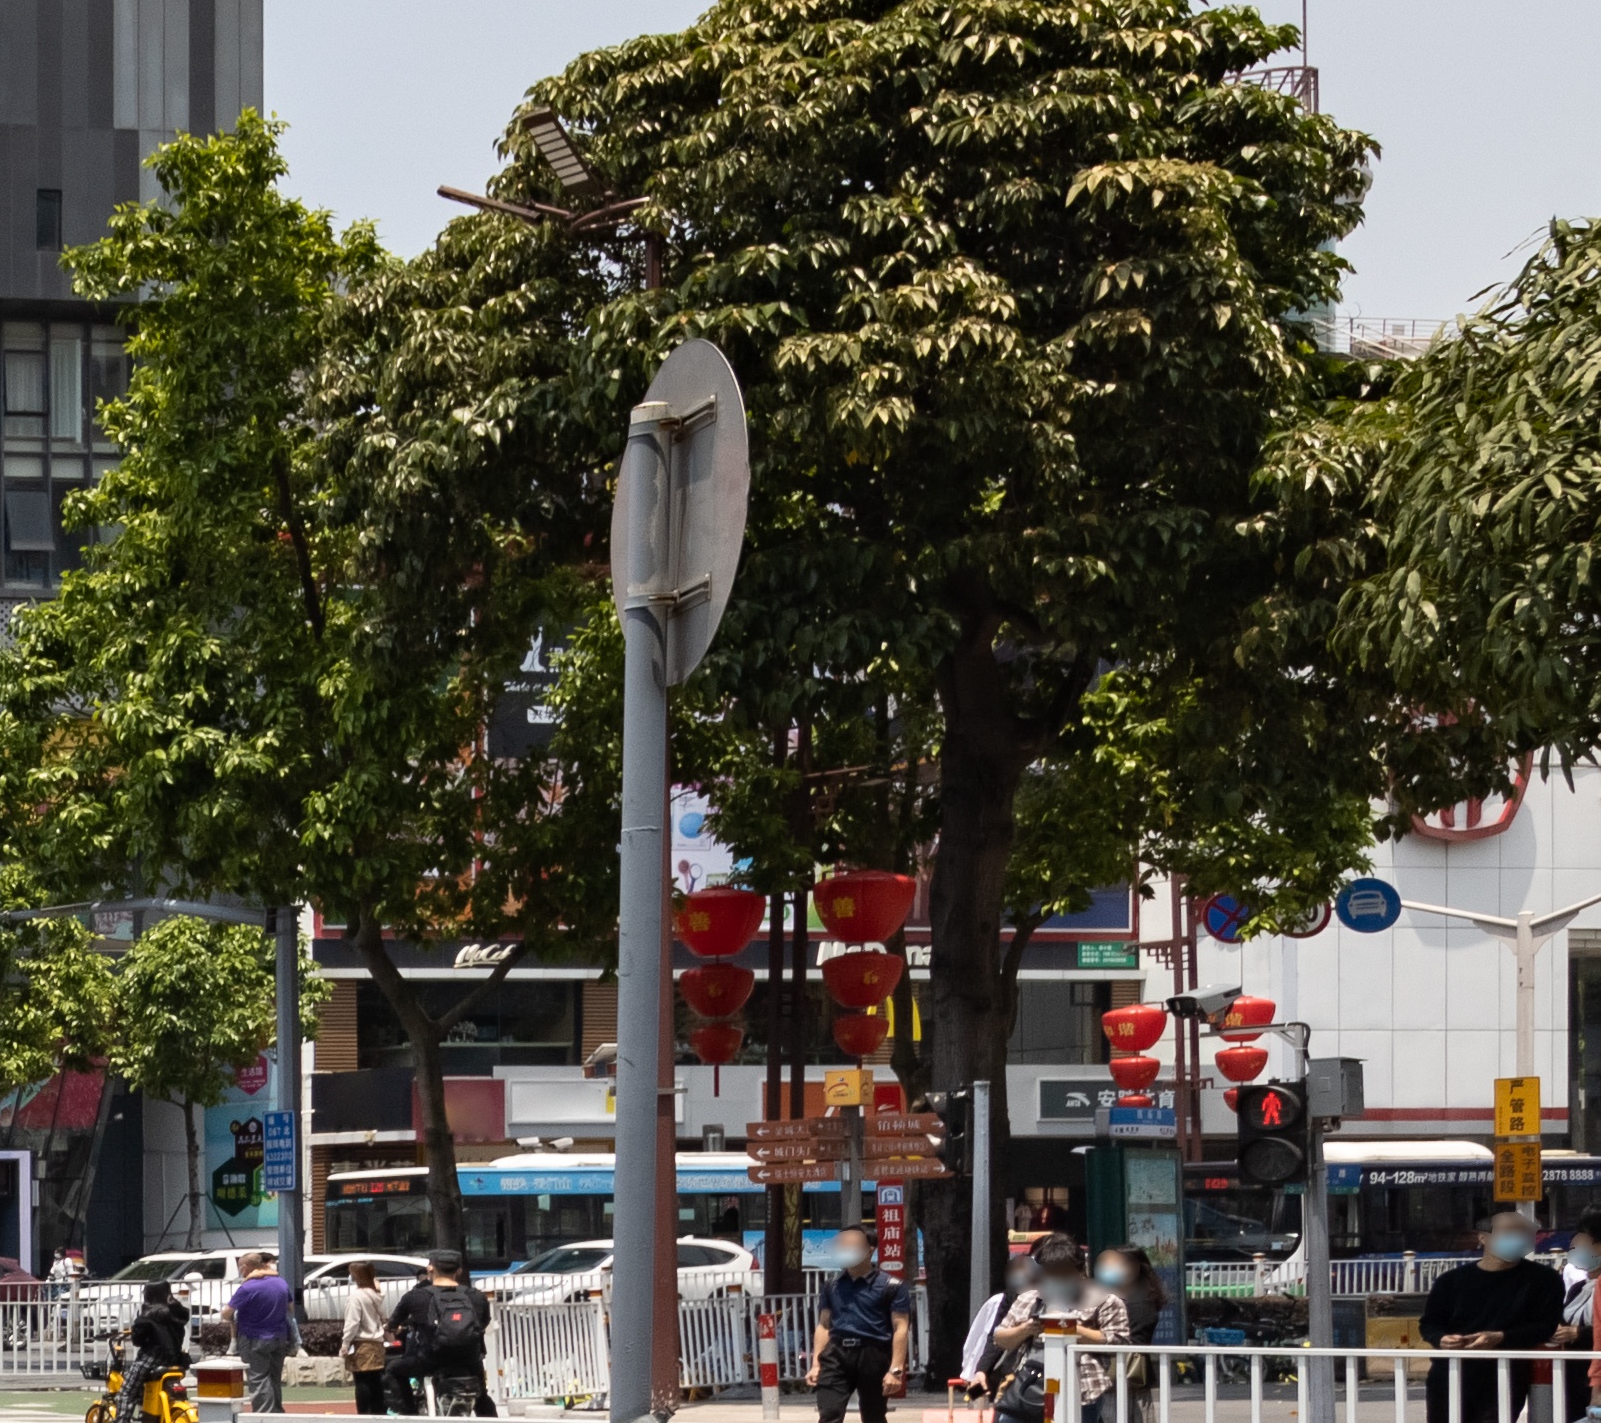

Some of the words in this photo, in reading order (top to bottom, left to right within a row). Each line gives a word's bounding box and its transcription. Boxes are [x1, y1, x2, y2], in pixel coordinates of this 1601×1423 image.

[1509, 1079, 1526, 1132] 严管路
[1500, 1149, 1515, 1194] 全路段
[1569, 1168, 1594, 1181] 8888
[882, 1208, 901, 1258] 祖庙站
